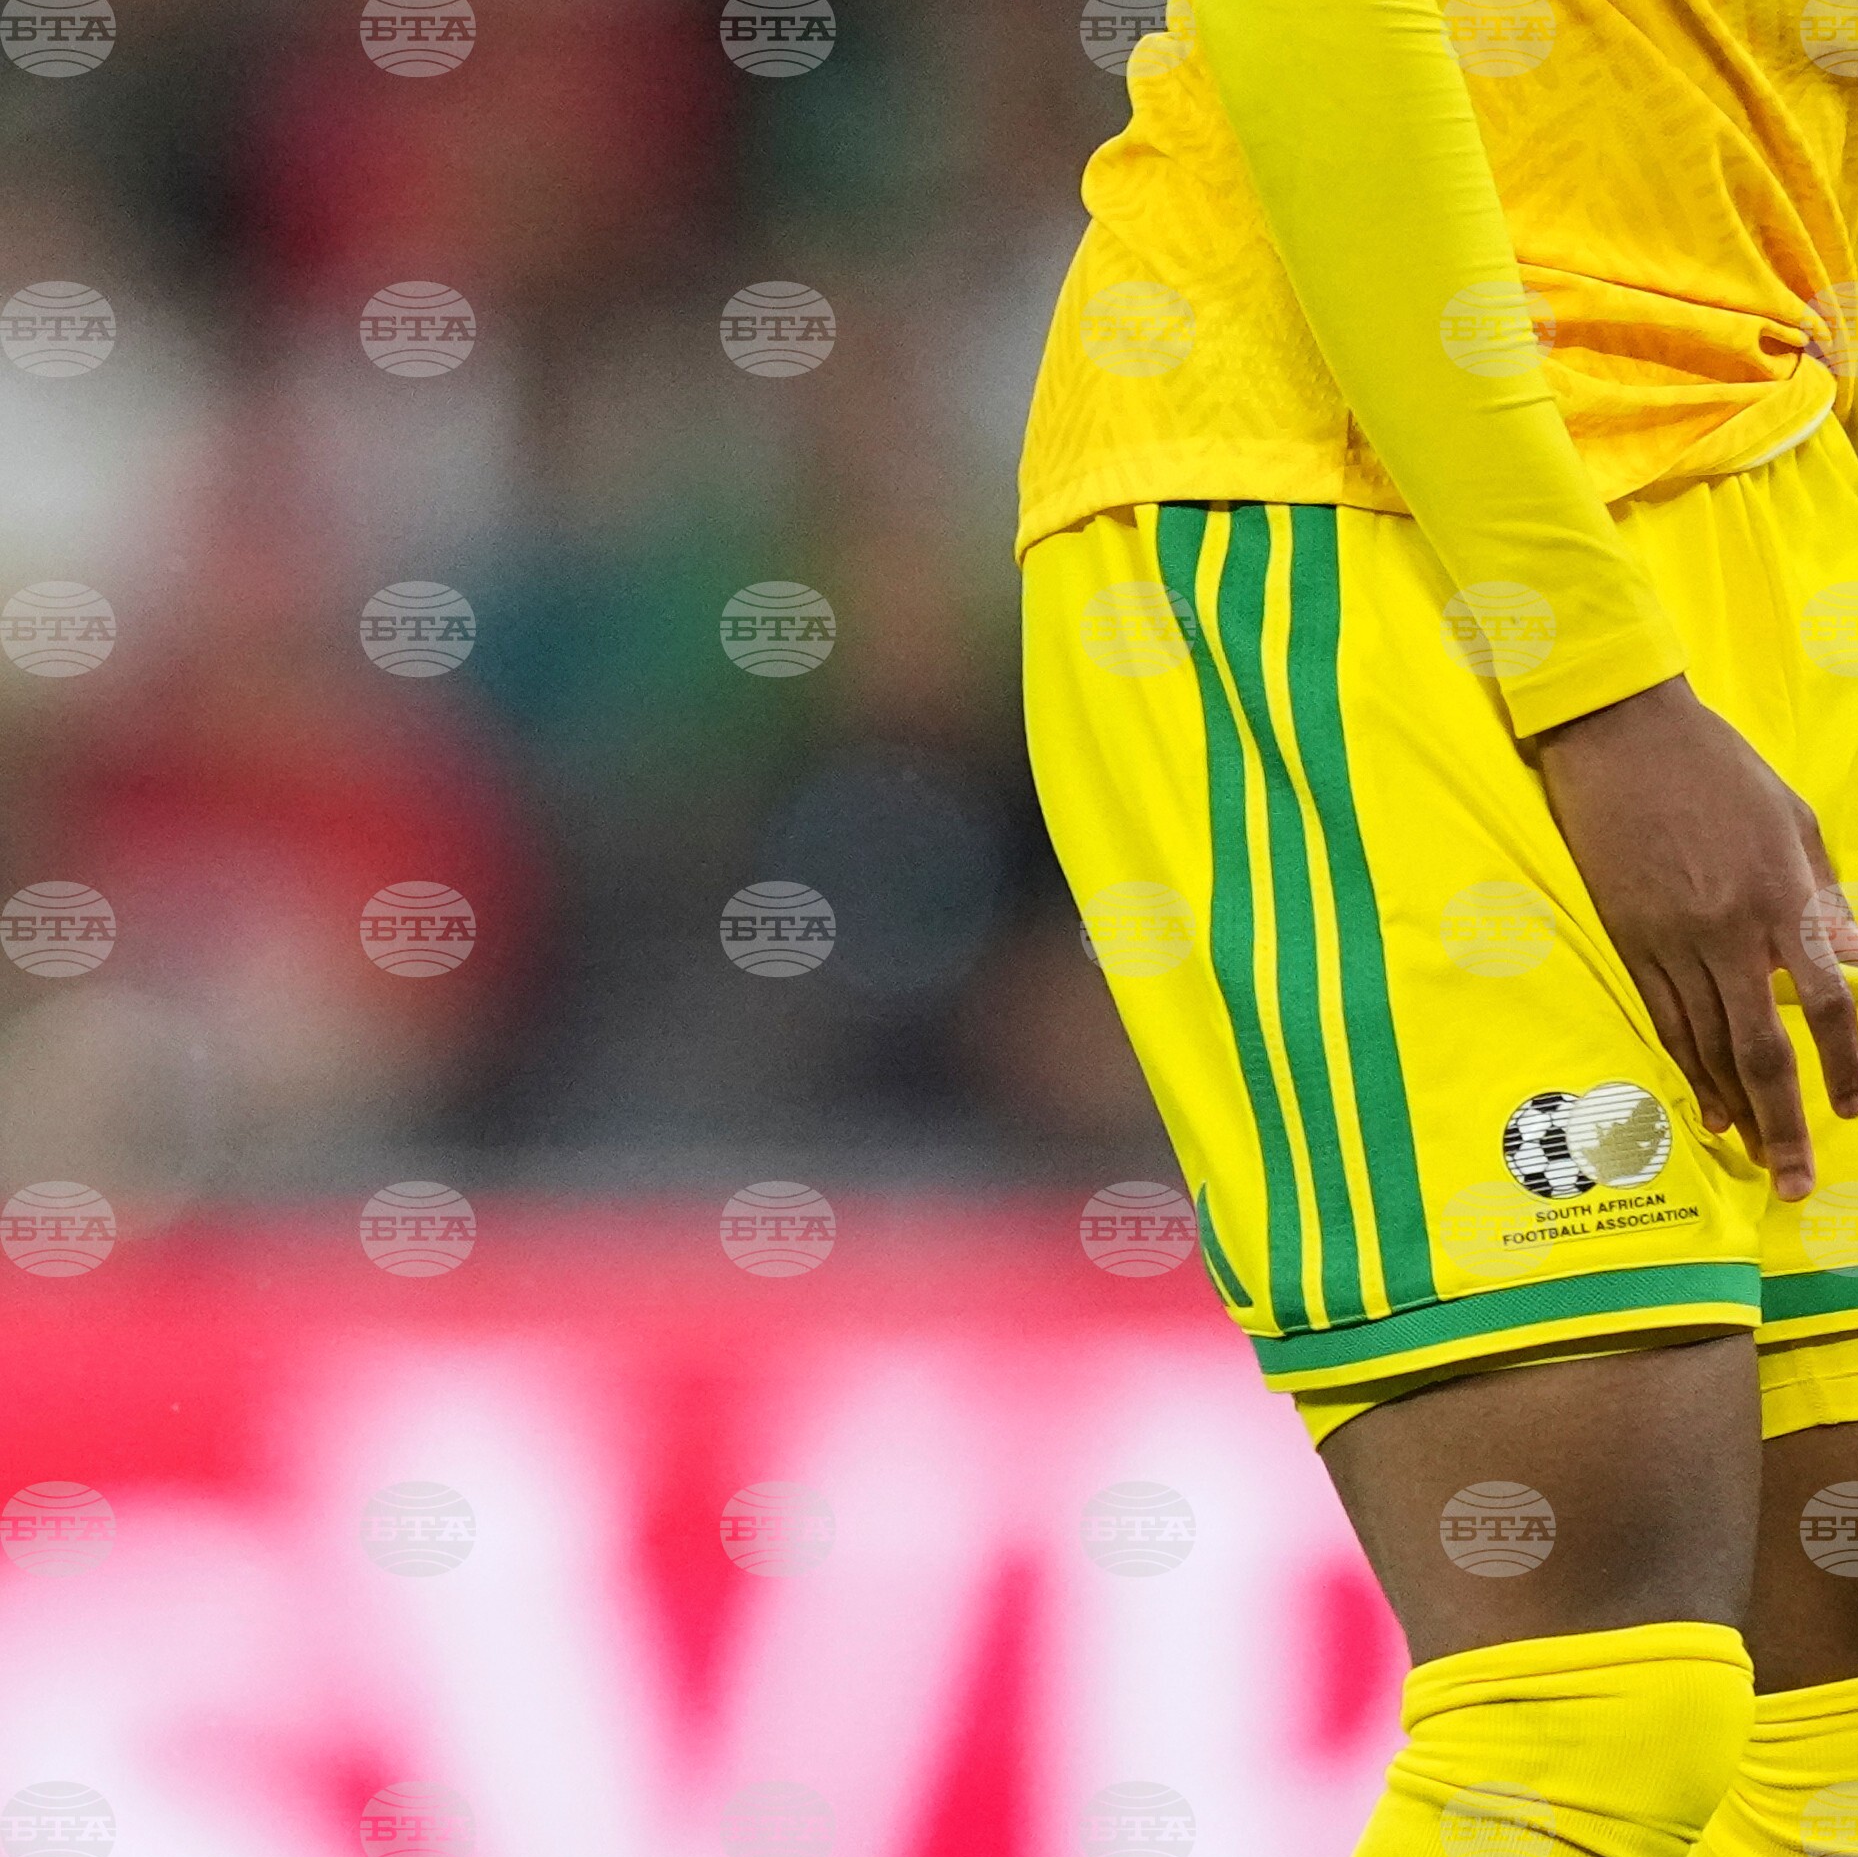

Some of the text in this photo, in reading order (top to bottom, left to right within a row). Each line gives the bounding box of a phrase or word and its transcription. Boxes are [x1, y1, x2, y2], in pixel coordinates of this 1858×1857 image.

[1502, 1205, 1700, 1246] FOOTBALL ASSOCIATION
[1535, 1193, 1666, 1224] SOUTH AFRICAN
